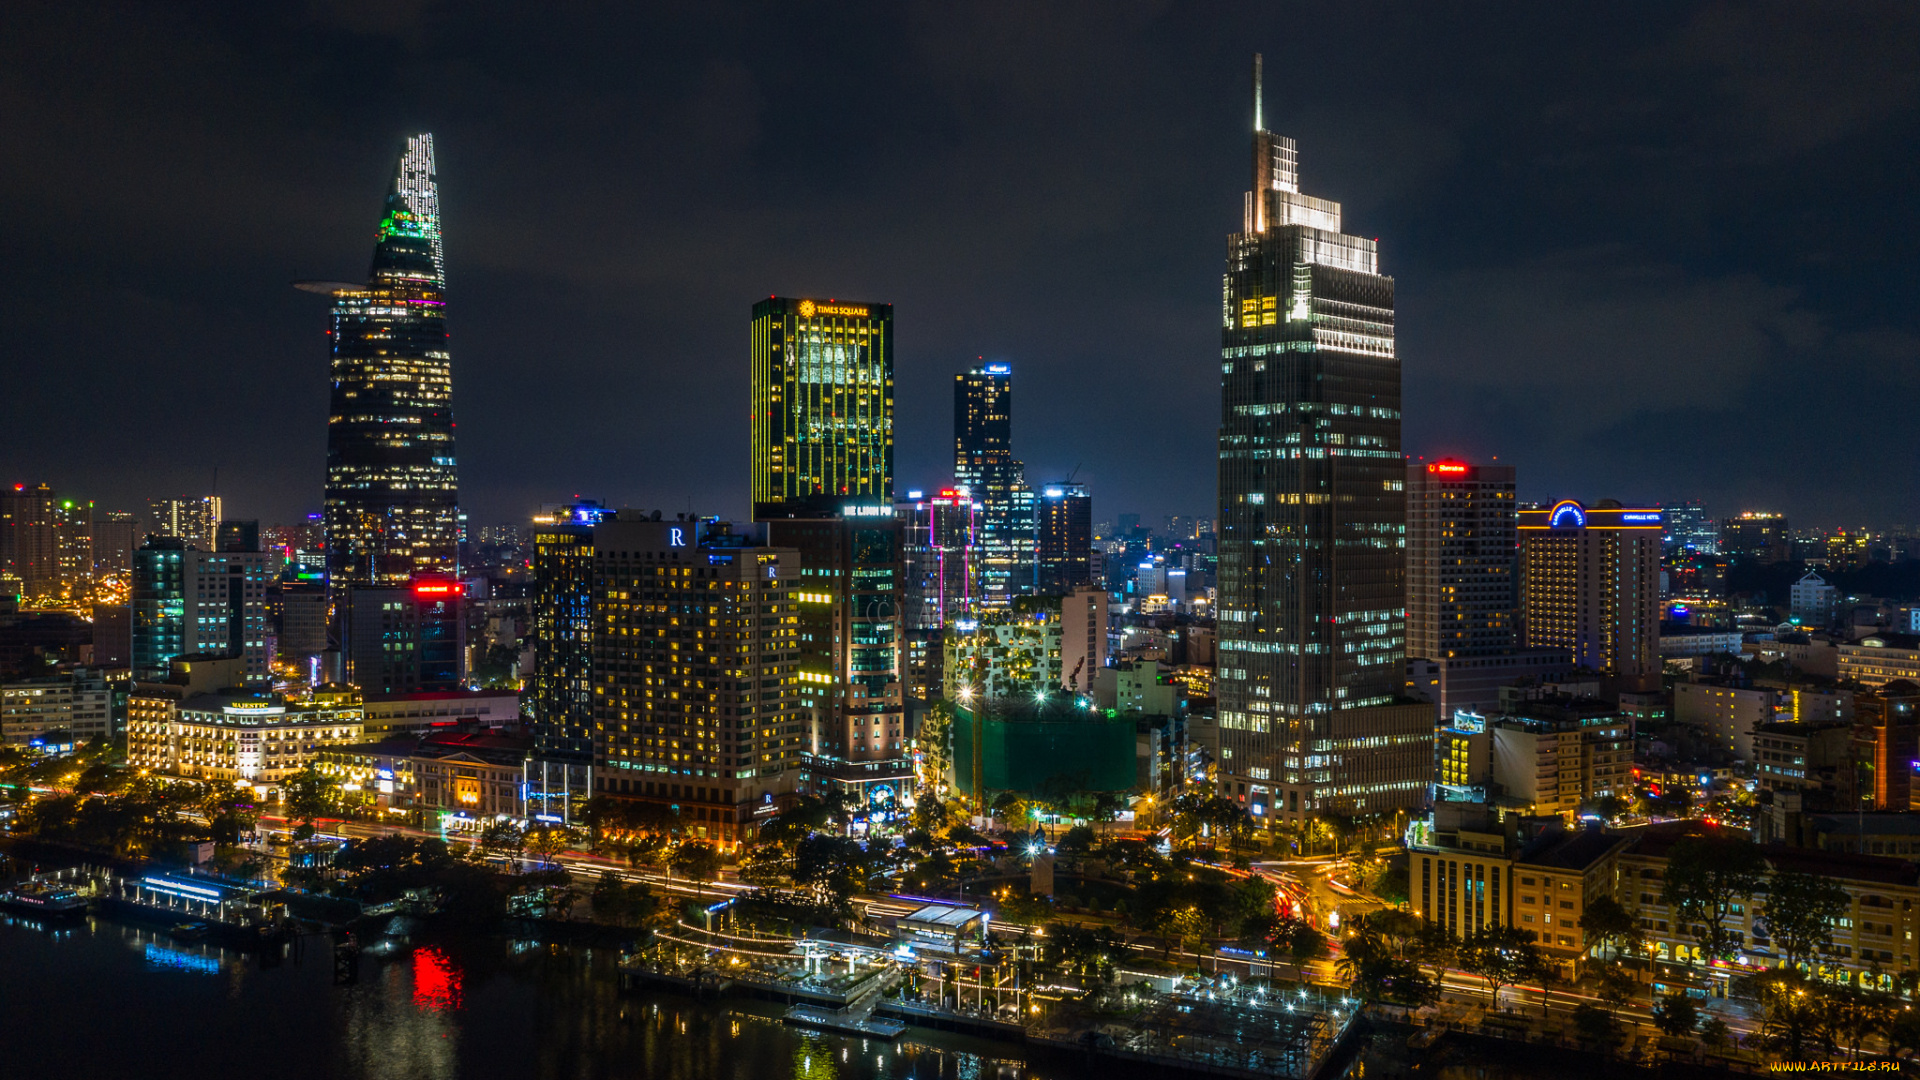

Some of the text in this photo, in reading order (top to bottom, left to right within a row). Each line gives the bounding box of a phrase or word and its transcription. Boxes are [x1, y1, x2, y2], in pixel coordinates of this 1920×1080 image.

[817, 305, 868, 316] TIMES SQUARE
[1553, 506, 1583, 526] CARAVELLE HOTEL
[671, 528, 686, 547] R
[768, 566, 777, 578] R
[765, 794, 772, 804] R
